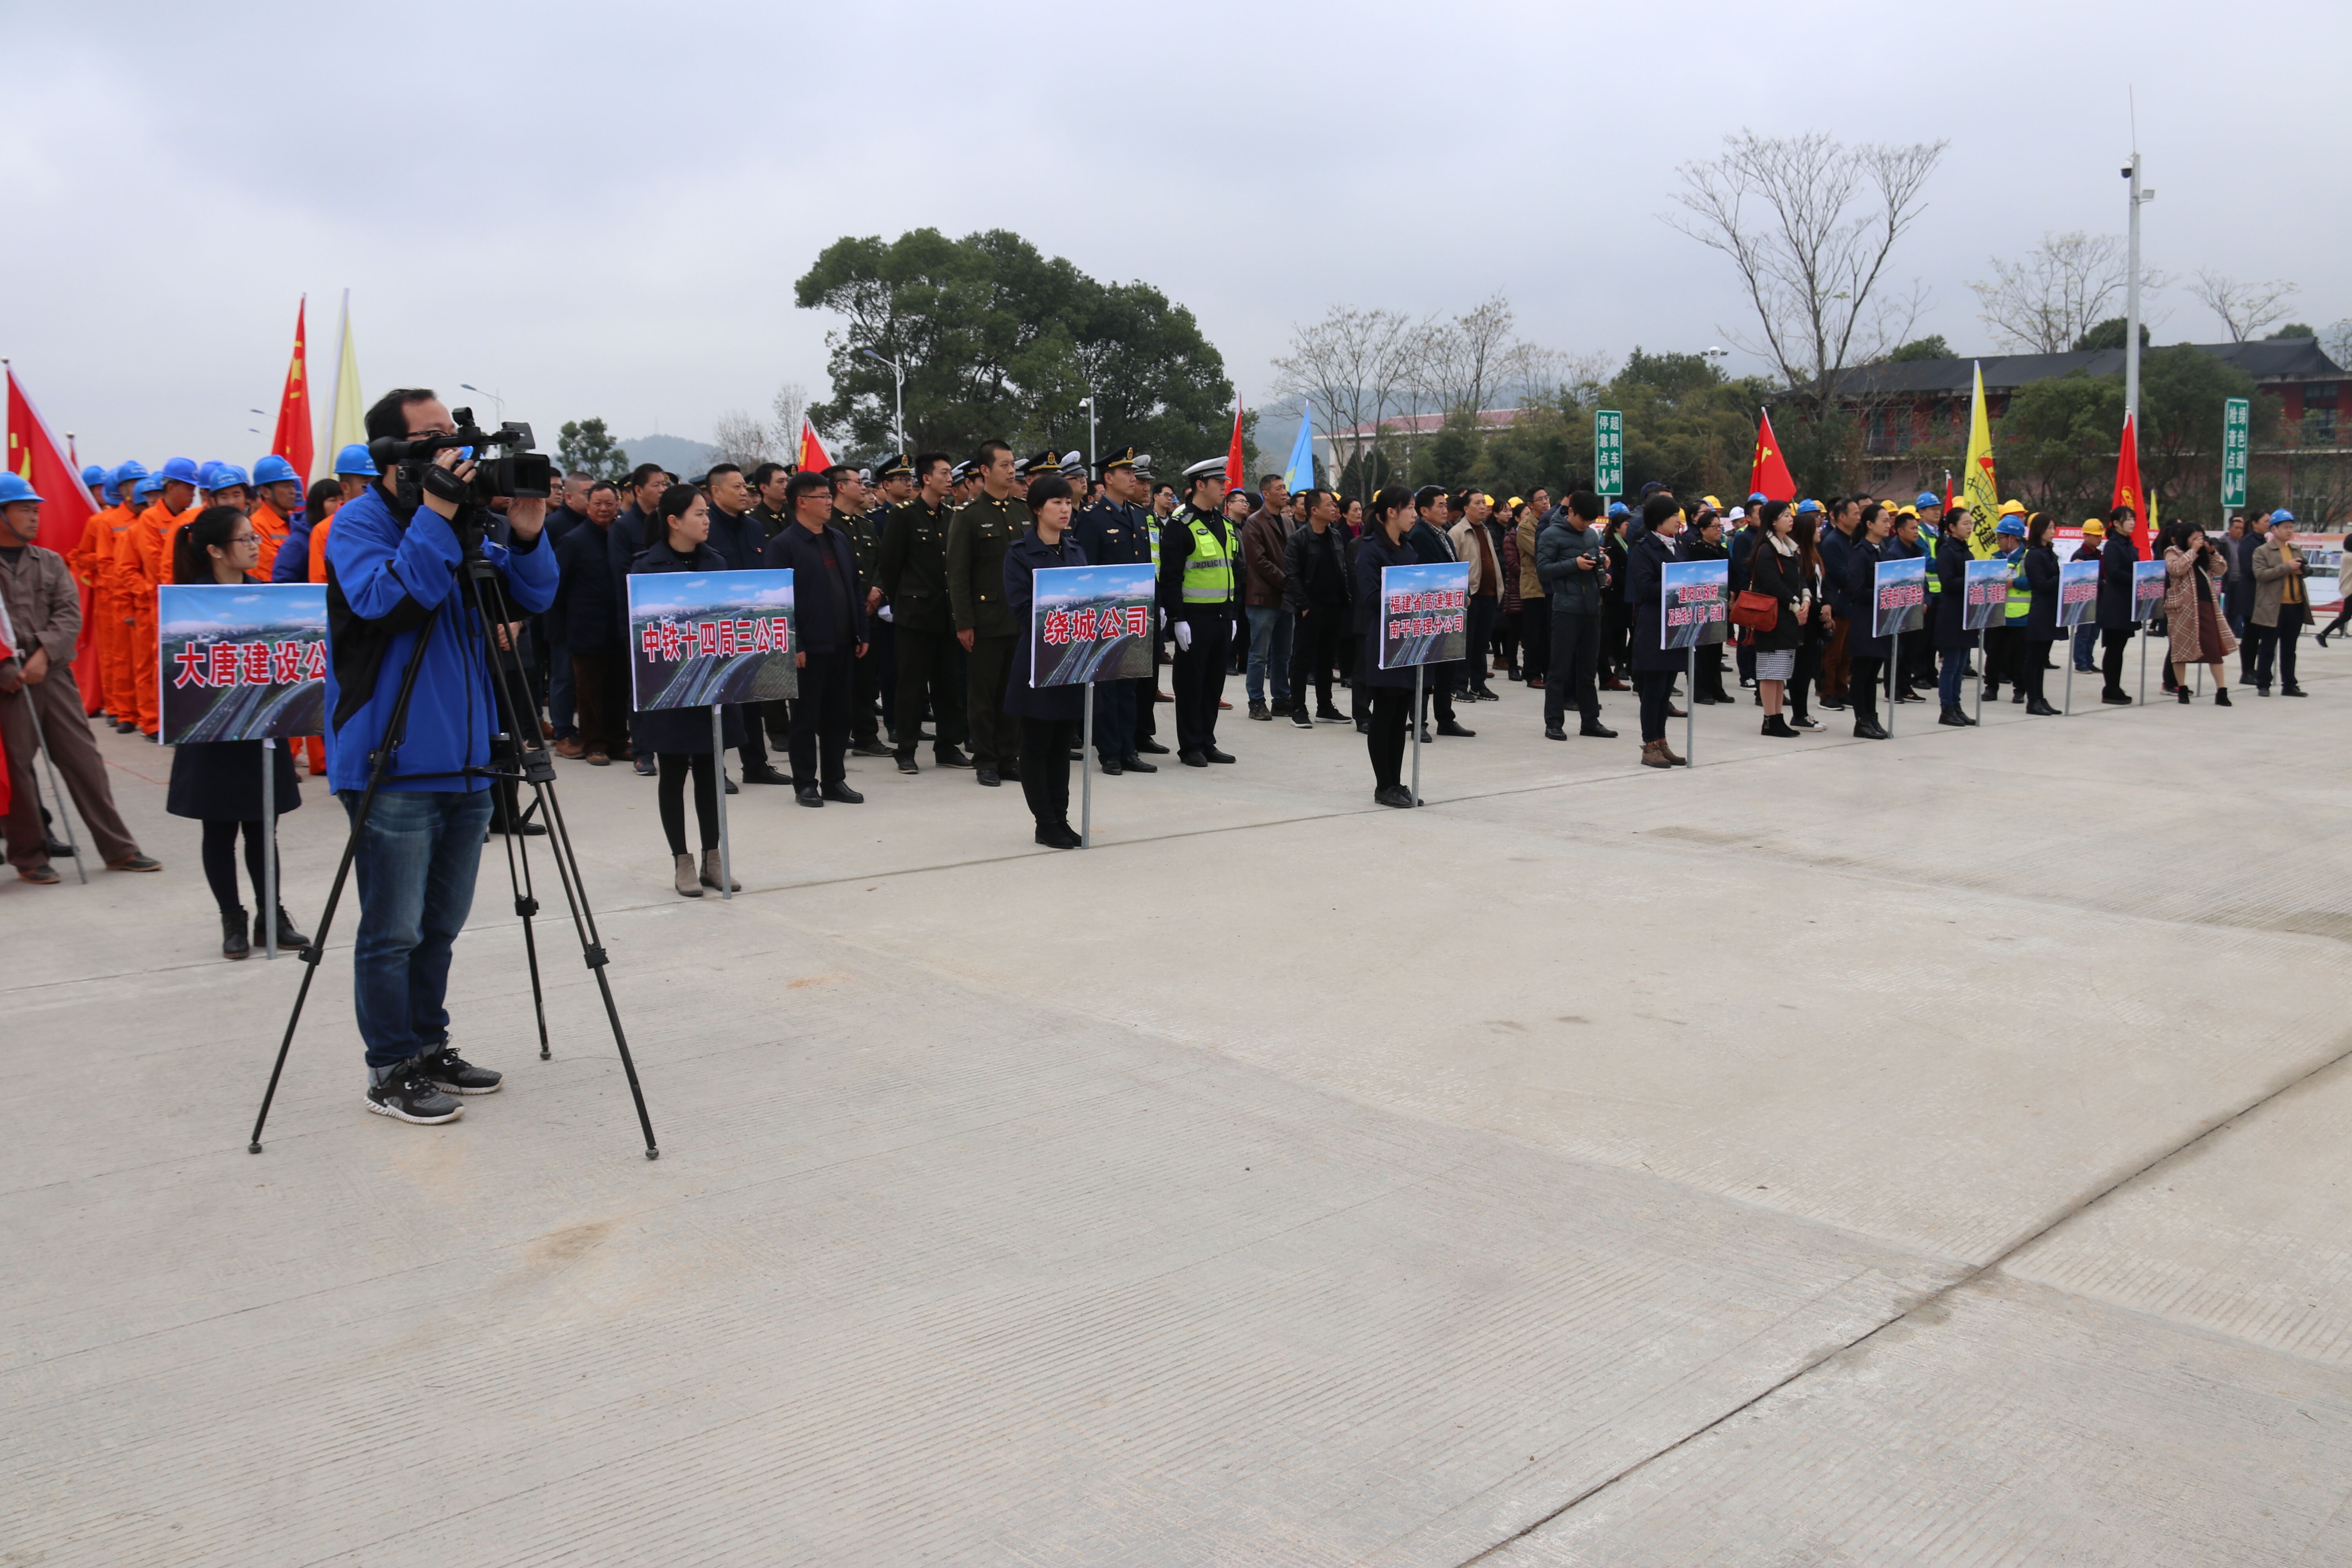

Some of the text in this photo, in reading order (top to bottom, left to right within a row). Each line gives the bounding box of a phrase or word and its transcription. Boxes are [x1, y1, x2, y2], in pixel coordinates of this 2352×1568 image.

[1599, 415, 1609, 466] 停靠点
[1610, 415, 1620, 484] 超限车辆
[2227, 405, 2237, 469] 检查点
[2235, 406, 2246, 492] 绿色通道
[1390, 590, 1465, 614] 福建省高速集团
[1678, 583, 1718, 604] 建阳区政府
[1879, 583, 1924, 610] 武夷新区管委会
[641, 617, 788, 663] 中铁十四局三公司
[1043, 605, 1147, 646] 绕城公司
[1389, 614, 1463, 639] 南平管理分公司
